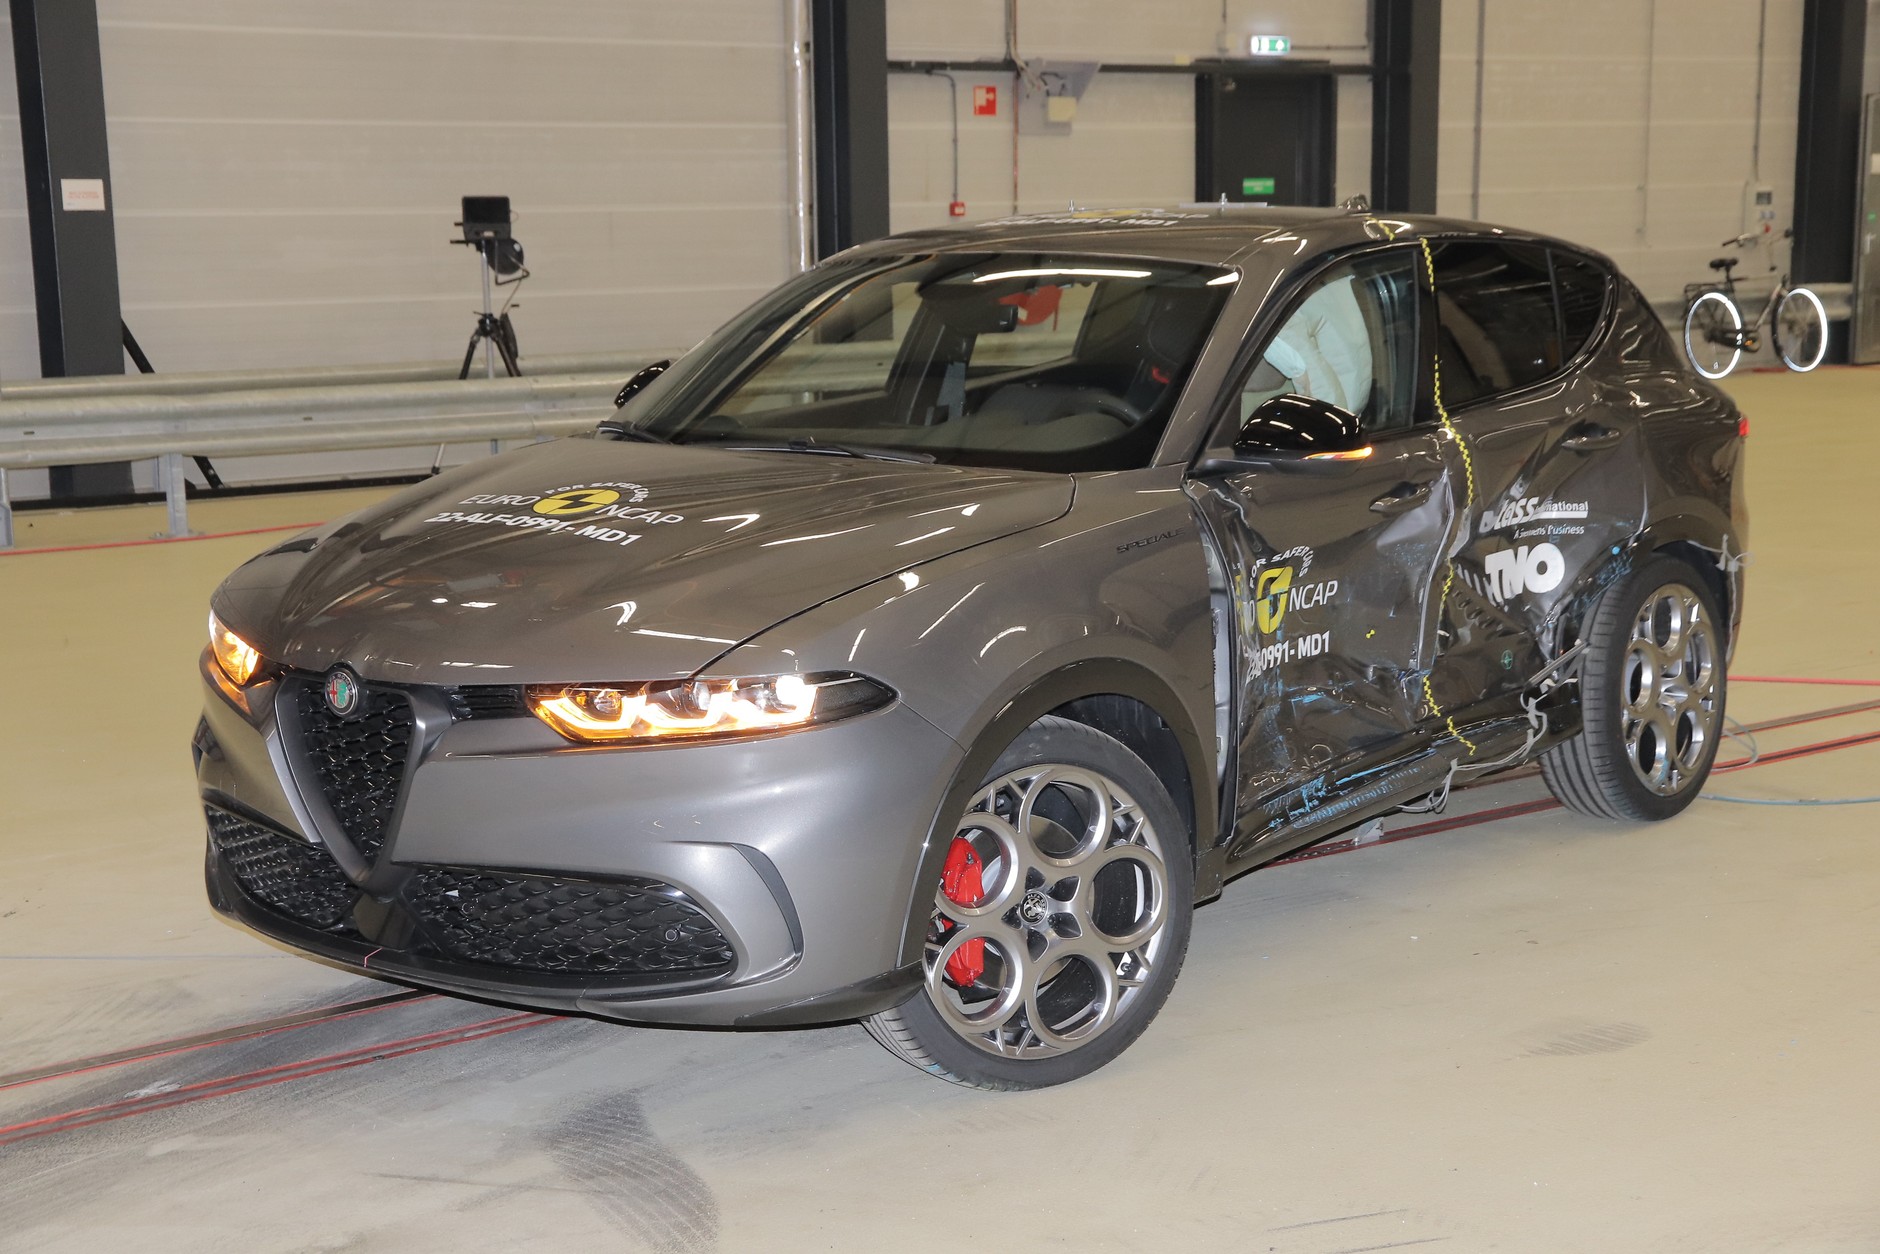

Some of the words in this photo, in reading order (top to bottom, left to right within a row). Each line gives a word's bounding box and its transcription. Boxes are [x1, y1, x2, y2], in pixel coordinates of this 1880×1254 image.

[545, 484, 585, 494] FOR
[590, 482, 642, 490] SAFER
[458, 494, 541, 507] EURO
[595, 504, 685, 525] NCAP
[1116, 528, 1185, 553] SPECIALE
[1270, 545, 1310, 563] SAFER
[1484, 542, 1566, 604] TNO
[1288, 580, 1339, 612] NCAP
